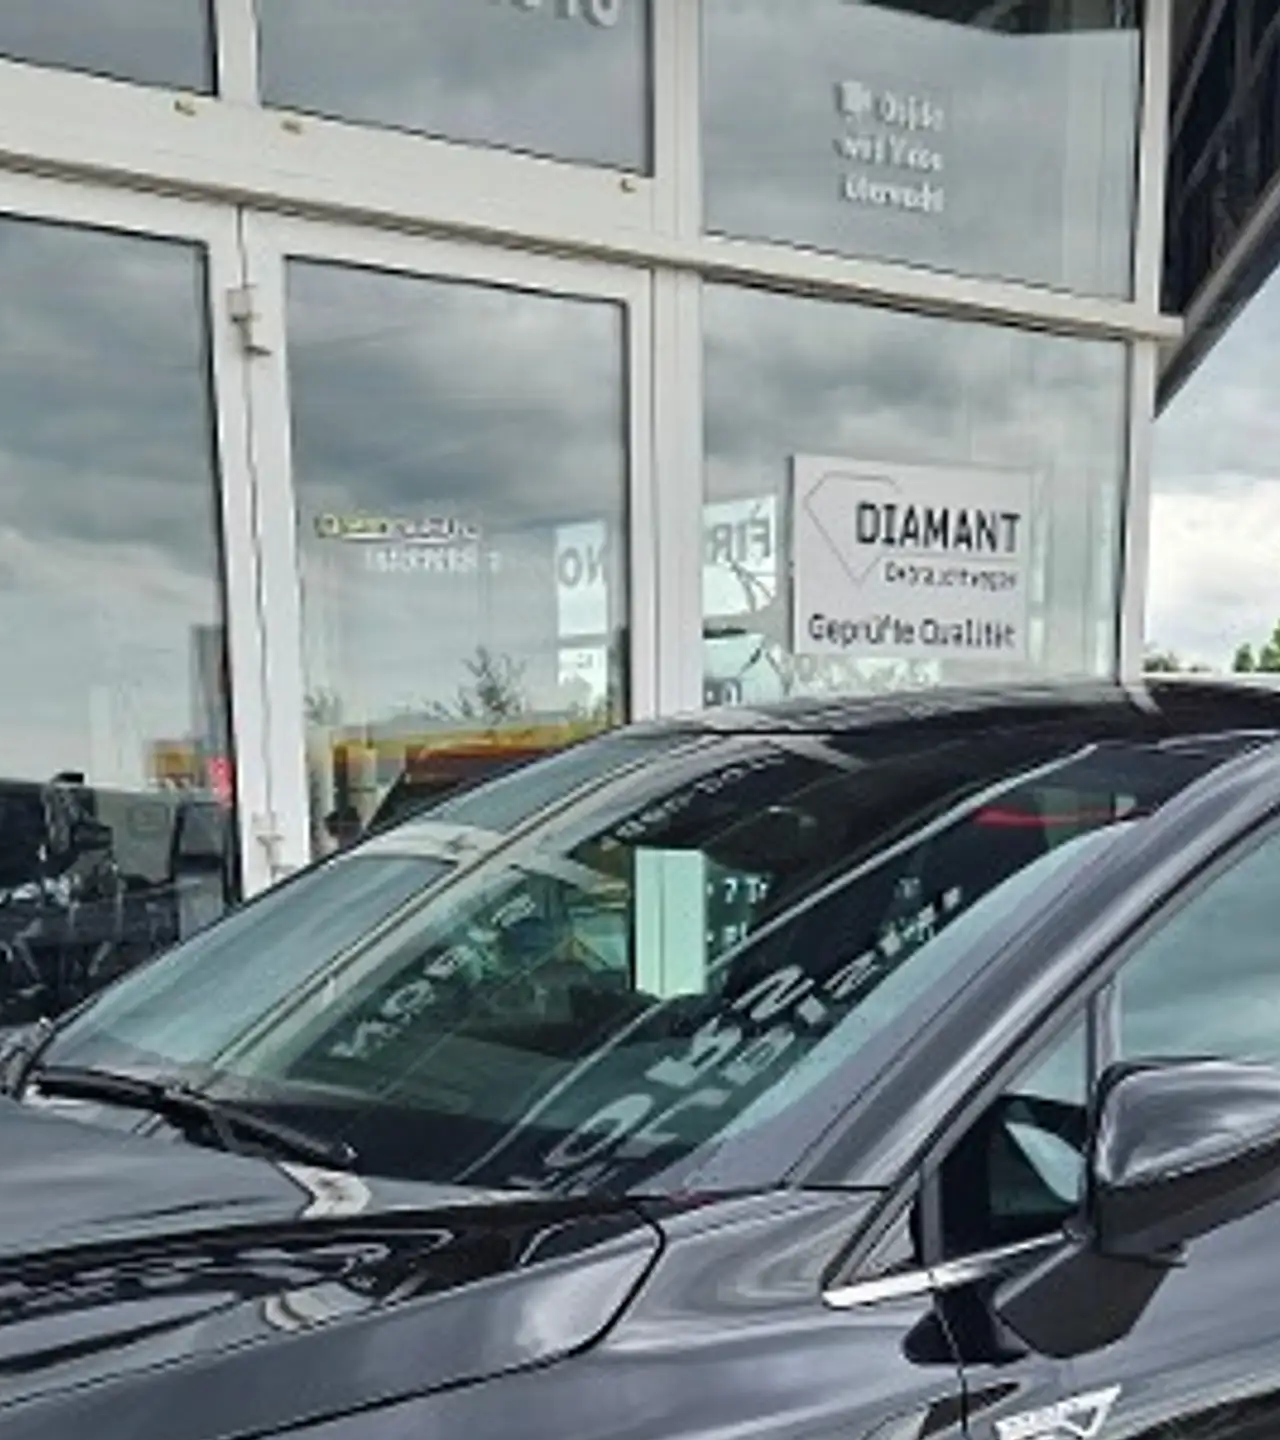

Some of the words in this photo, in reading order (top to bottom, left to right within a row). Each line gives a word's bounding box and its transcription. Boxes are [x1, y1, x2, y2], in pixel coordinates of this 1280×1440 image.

[856, 500, 1021, 553] DIAMANT
[808, 613, 916, 648] Geprüfte
[920, 616, 1017, 650] Qualität
